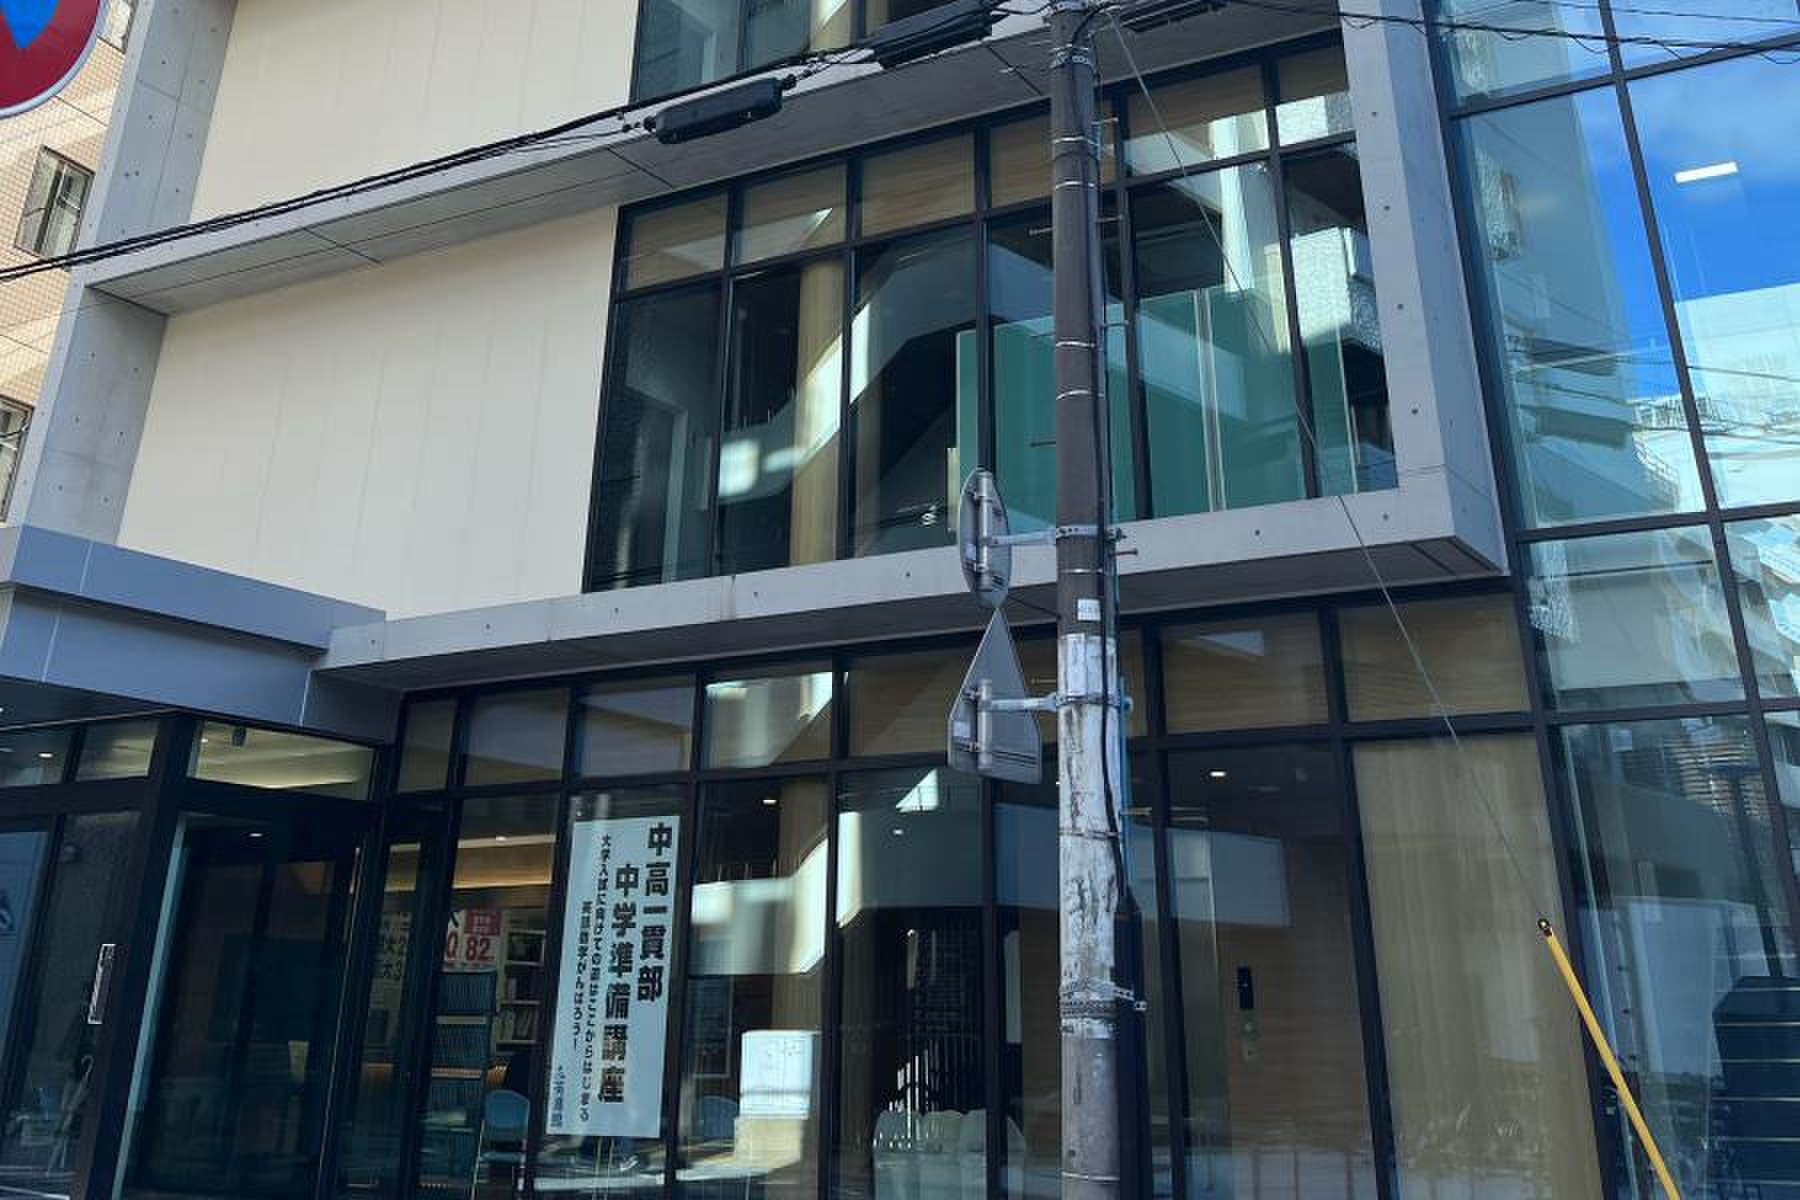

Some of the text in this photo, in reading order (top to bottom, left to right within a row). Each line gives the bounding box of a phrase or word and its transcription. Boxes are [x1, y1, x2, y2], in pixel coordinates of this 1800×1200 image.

[598, 863, 640, 1103] 中学準備講座
[637, 822, 673, 1002] 中高一貫部
